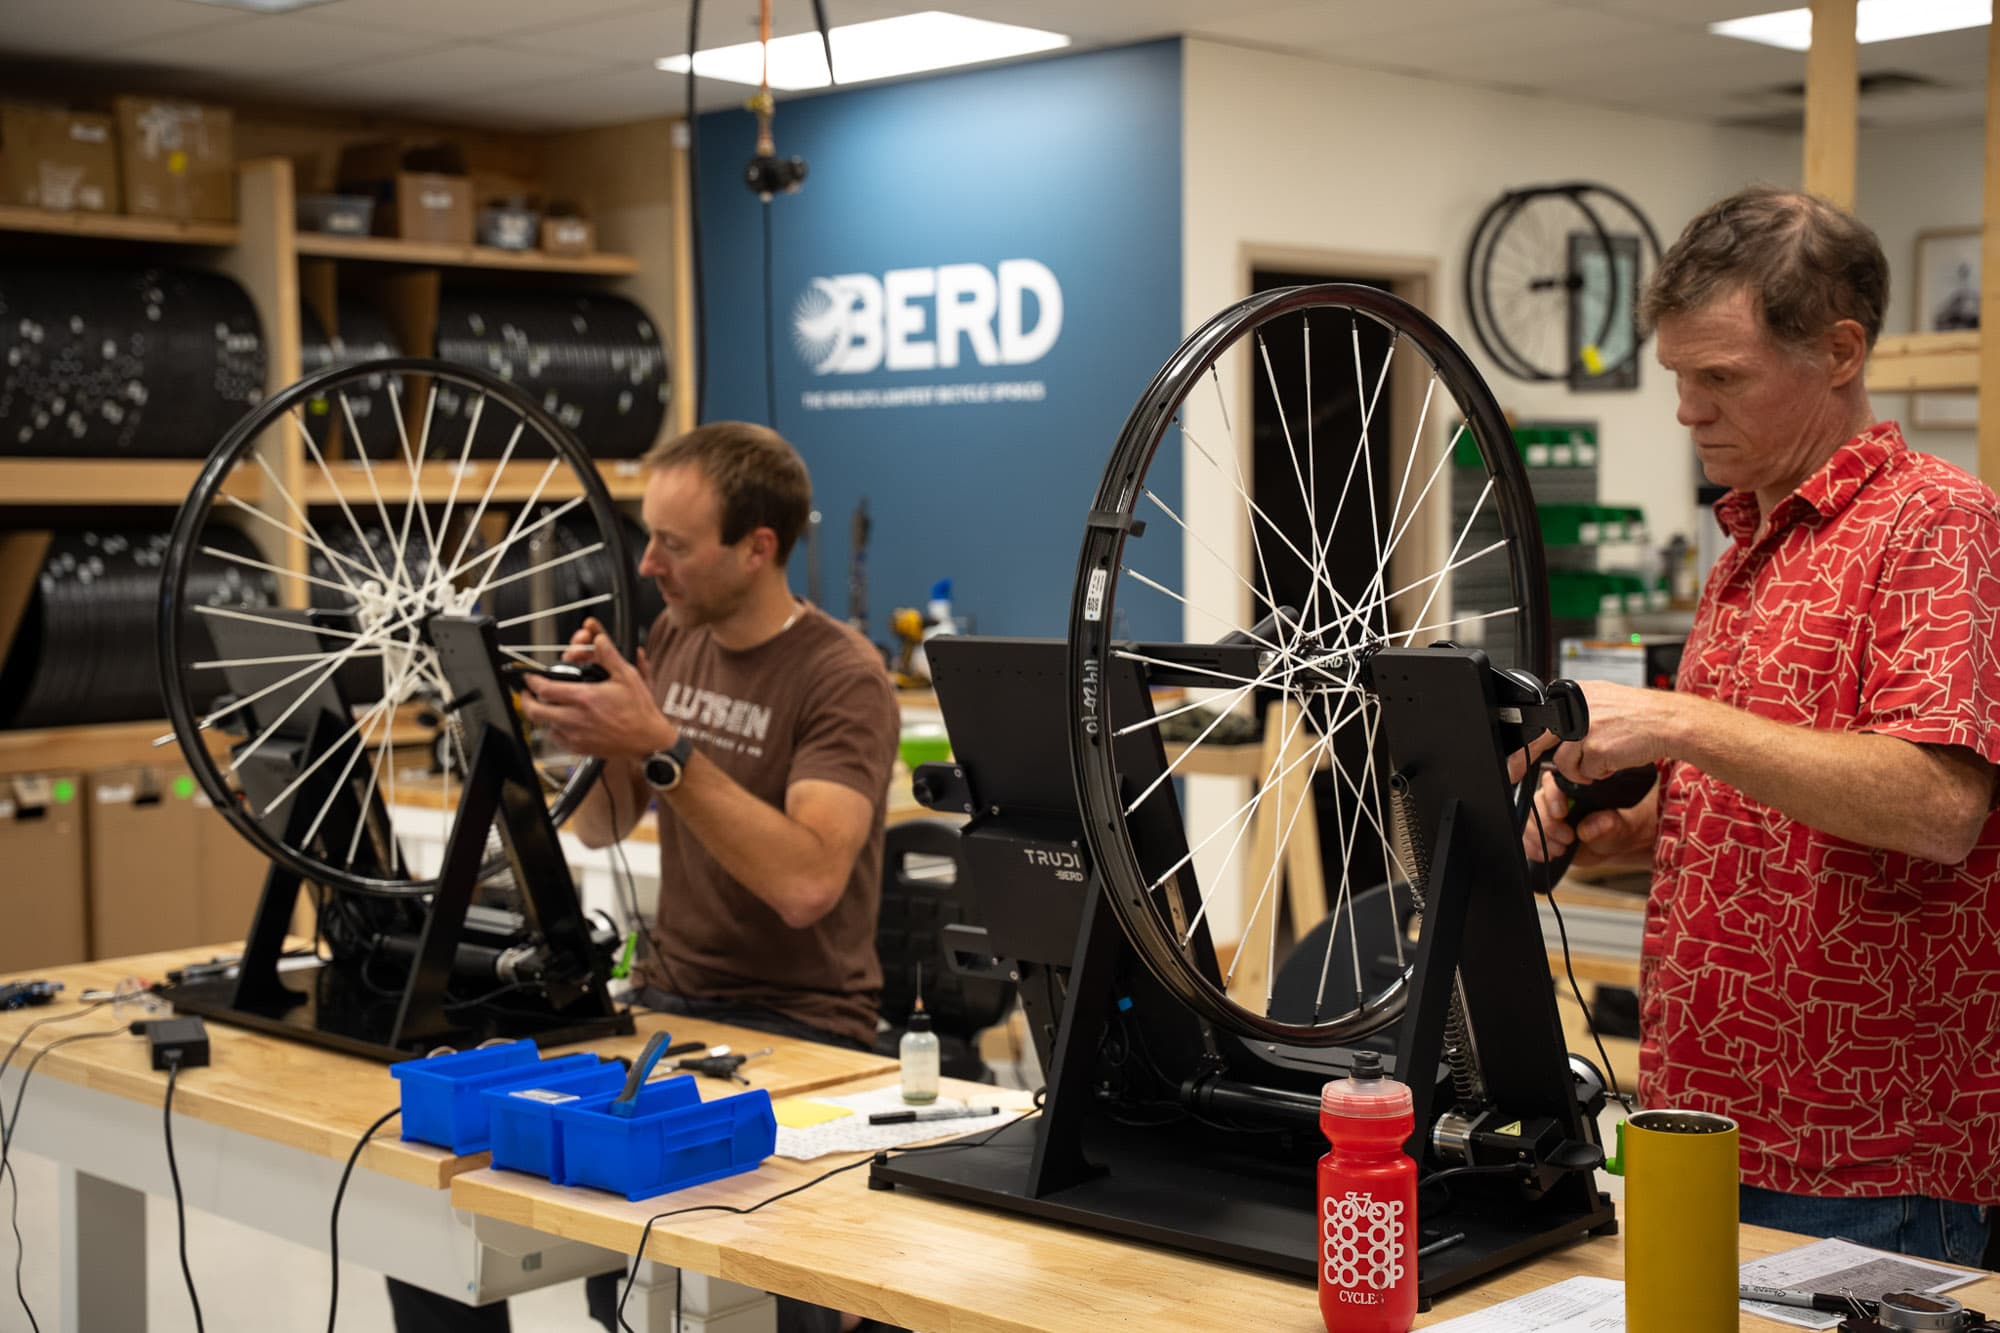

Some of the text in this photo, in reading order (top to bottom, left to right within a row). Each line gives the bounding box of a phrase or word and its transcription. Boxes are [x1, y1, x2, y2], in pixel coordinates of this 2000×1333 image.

[808, 258, 1064, 375] BERD
[662, 681, 772, 741] LUTSEN
[1023, 848, 1081, 869] TRUDI
[1323, 1261, 1404, 1290] CO-OP
